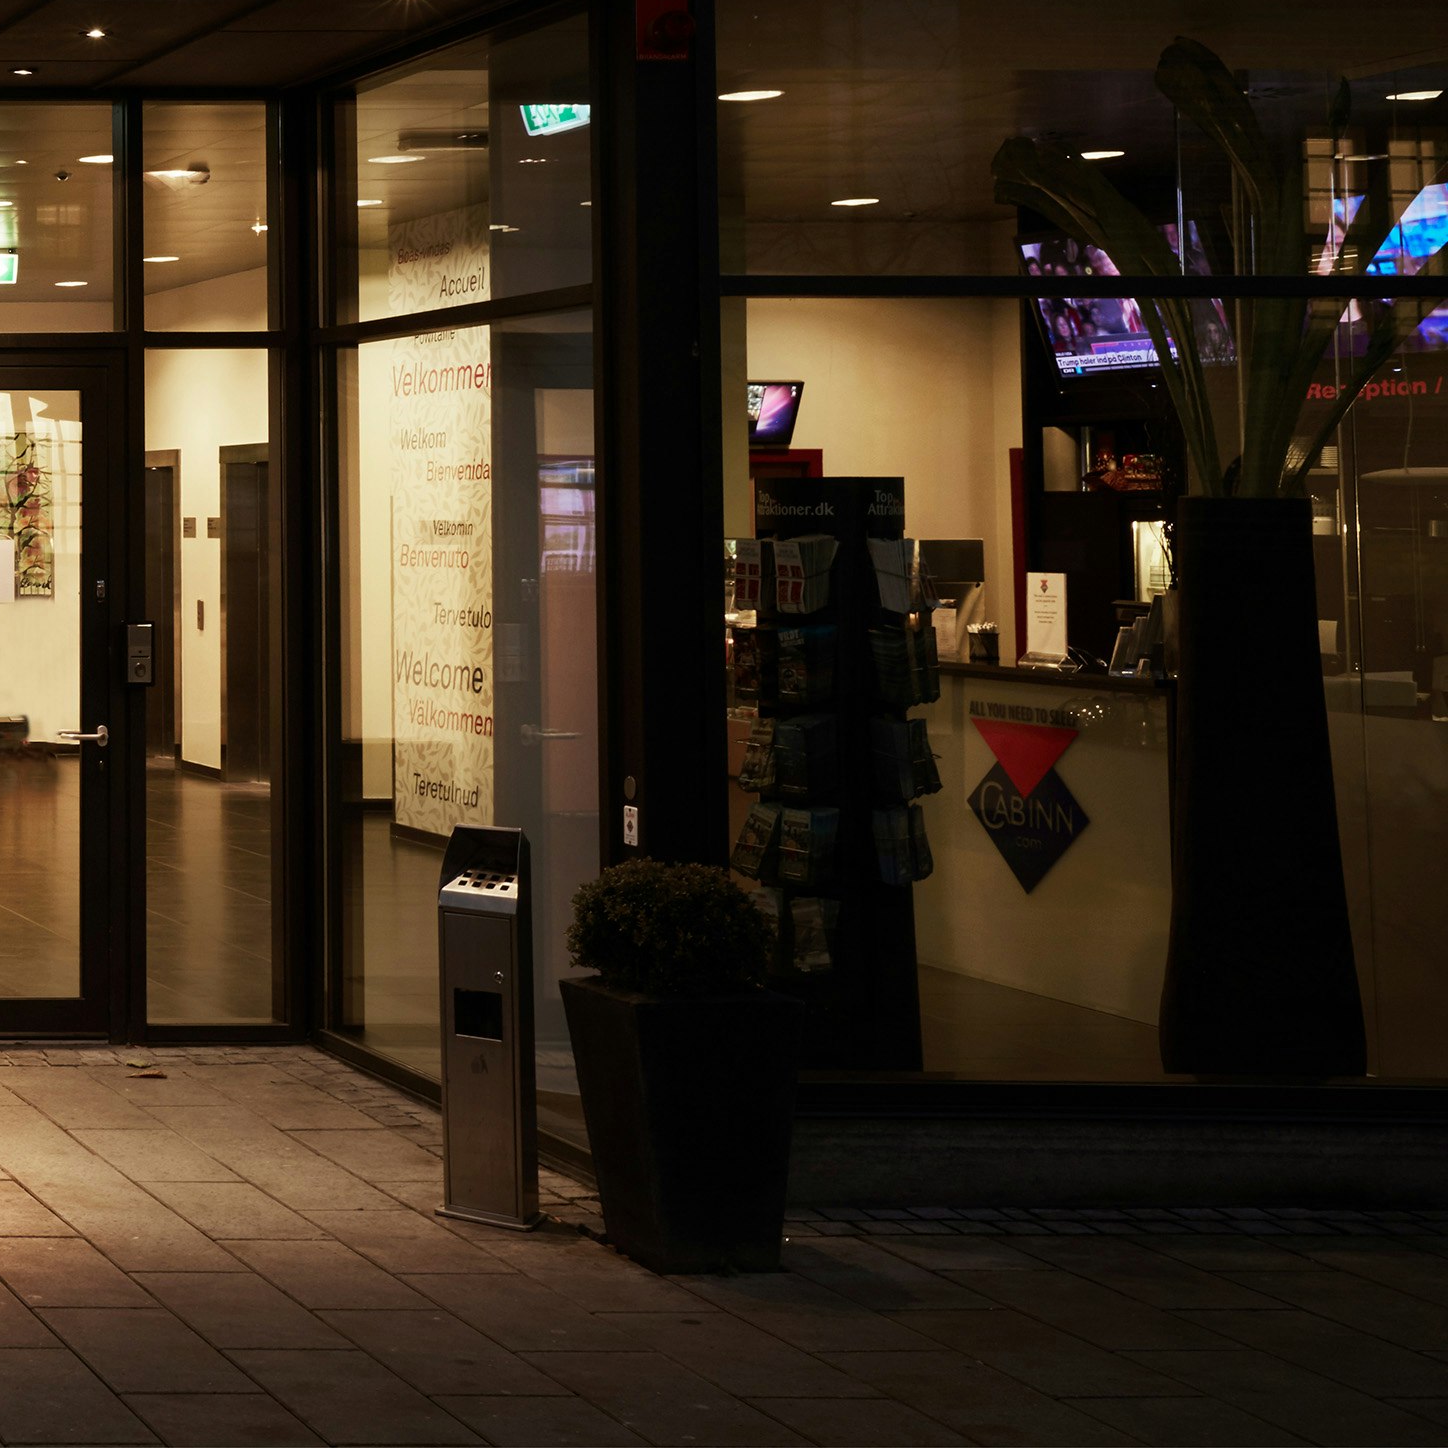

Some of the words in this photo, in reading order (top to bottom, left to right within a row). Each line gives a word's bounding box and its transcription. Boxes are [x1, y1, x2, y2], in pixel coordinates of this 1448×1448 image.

[440, 267, 485, 298] Accueil
[1058, 358, 1079, 367] Trump
[1080, 357, 1096, 365] haler
[1117, 354, 1143, 364] Clinton
[1305, 379, 1427, 401] Reption
[400, 427, 446, 450] Welkom
[426, 458, 491, 482] Bienvenida
[433, 520, 473, 536] Velkomin
[400, 543, 469, 569] Benvenuto
[396, 649, 484, 694] Welcome
[409, 698, 493, 737] Välkommen
[969, 700, 986, 716] ALL
[986, 702, 1006, 718] YOU
[1007, 704, 1033, 722] NEED
[1034, 707, 1048, 724] TO
[413, 772, 479, 808] Teretulnud
[979, 781, 1074, 836] CABINN
